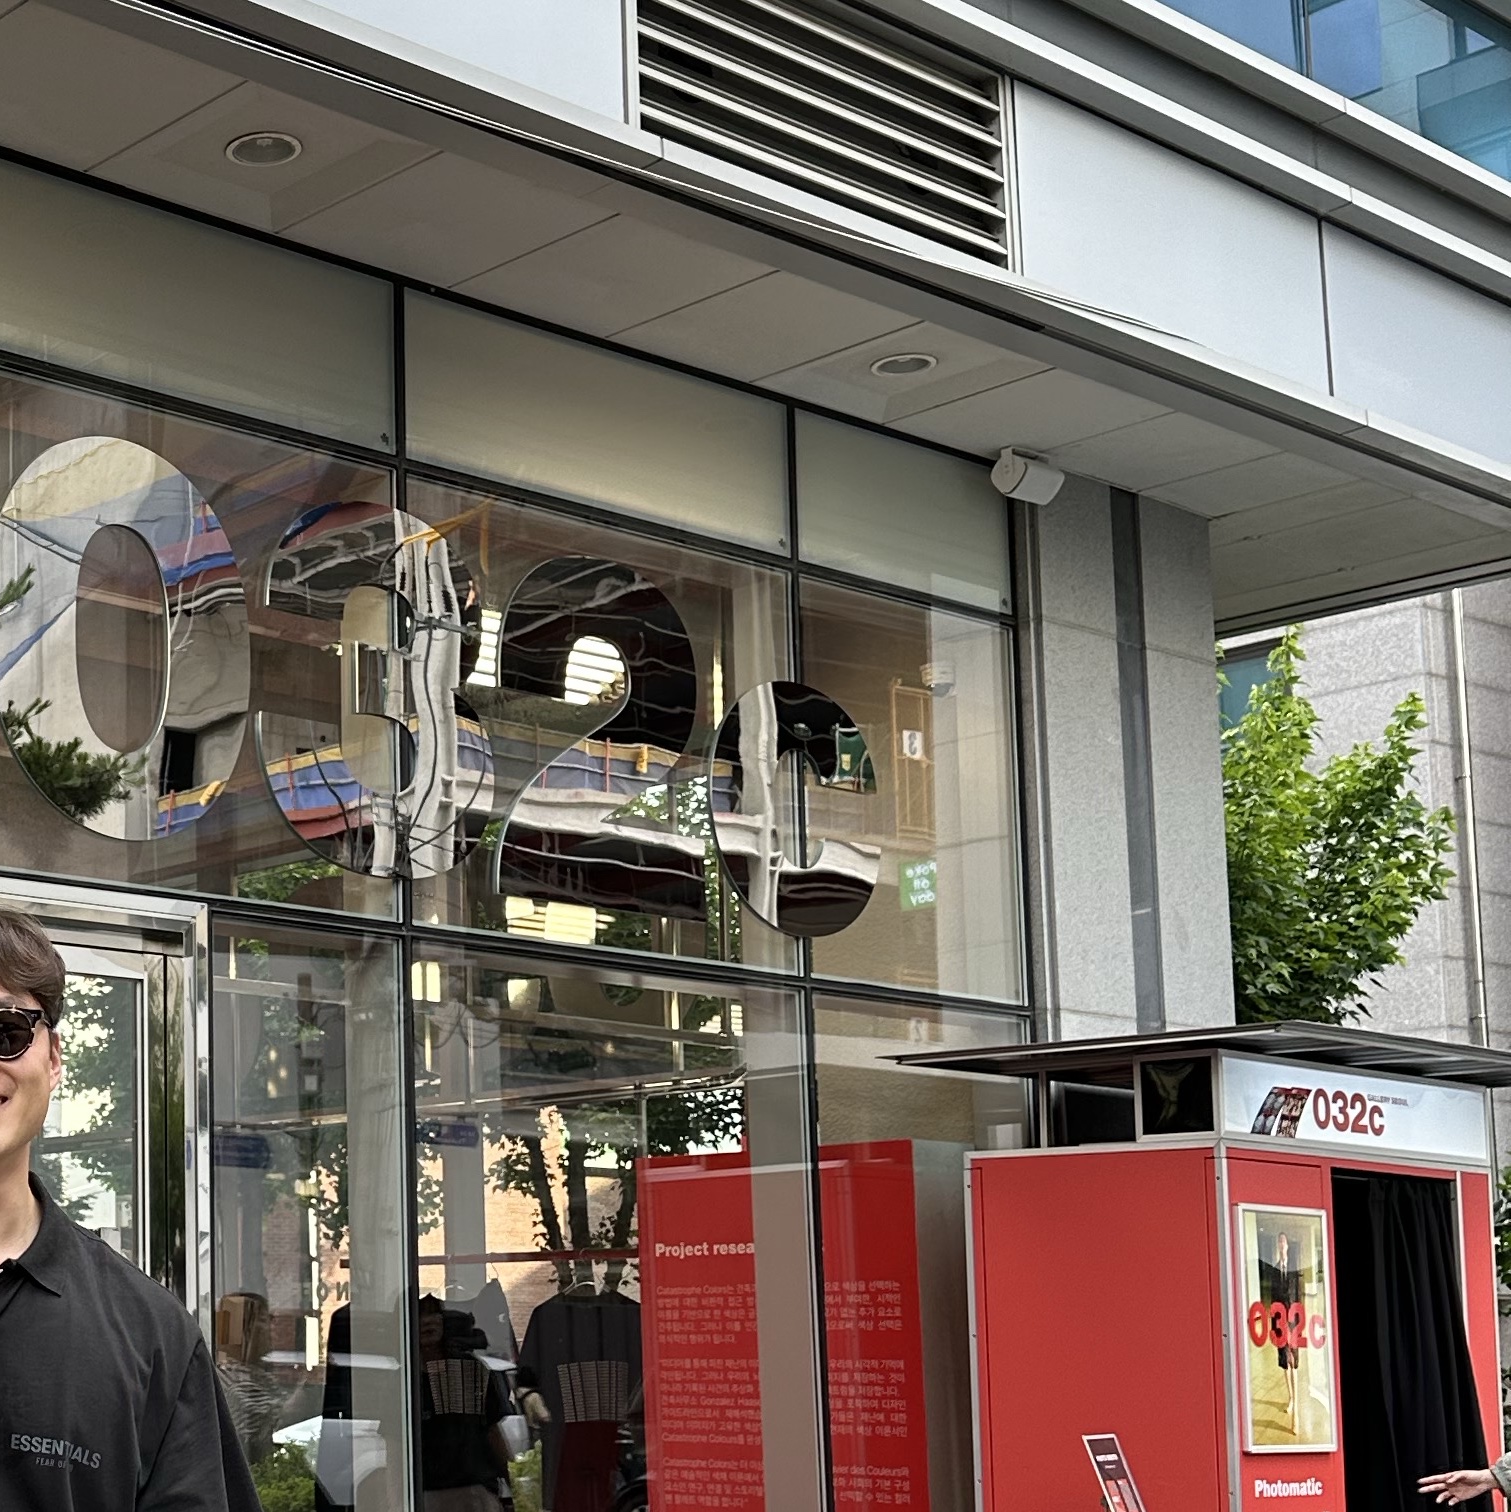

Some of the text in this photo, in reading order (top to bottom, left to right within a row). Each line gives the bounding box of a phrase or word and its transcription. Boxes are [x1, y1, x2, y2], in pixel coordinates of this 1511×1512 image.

[1312, 1087, 1385, 1137] 032c
[655, 1242, 709, 1259] Project
[1248, 1301, 1327, 1350] 032c
[10, 1433, 102, 1469] ESSENTIALS
[1254, 1476, 1323, 1499] Photomatic
